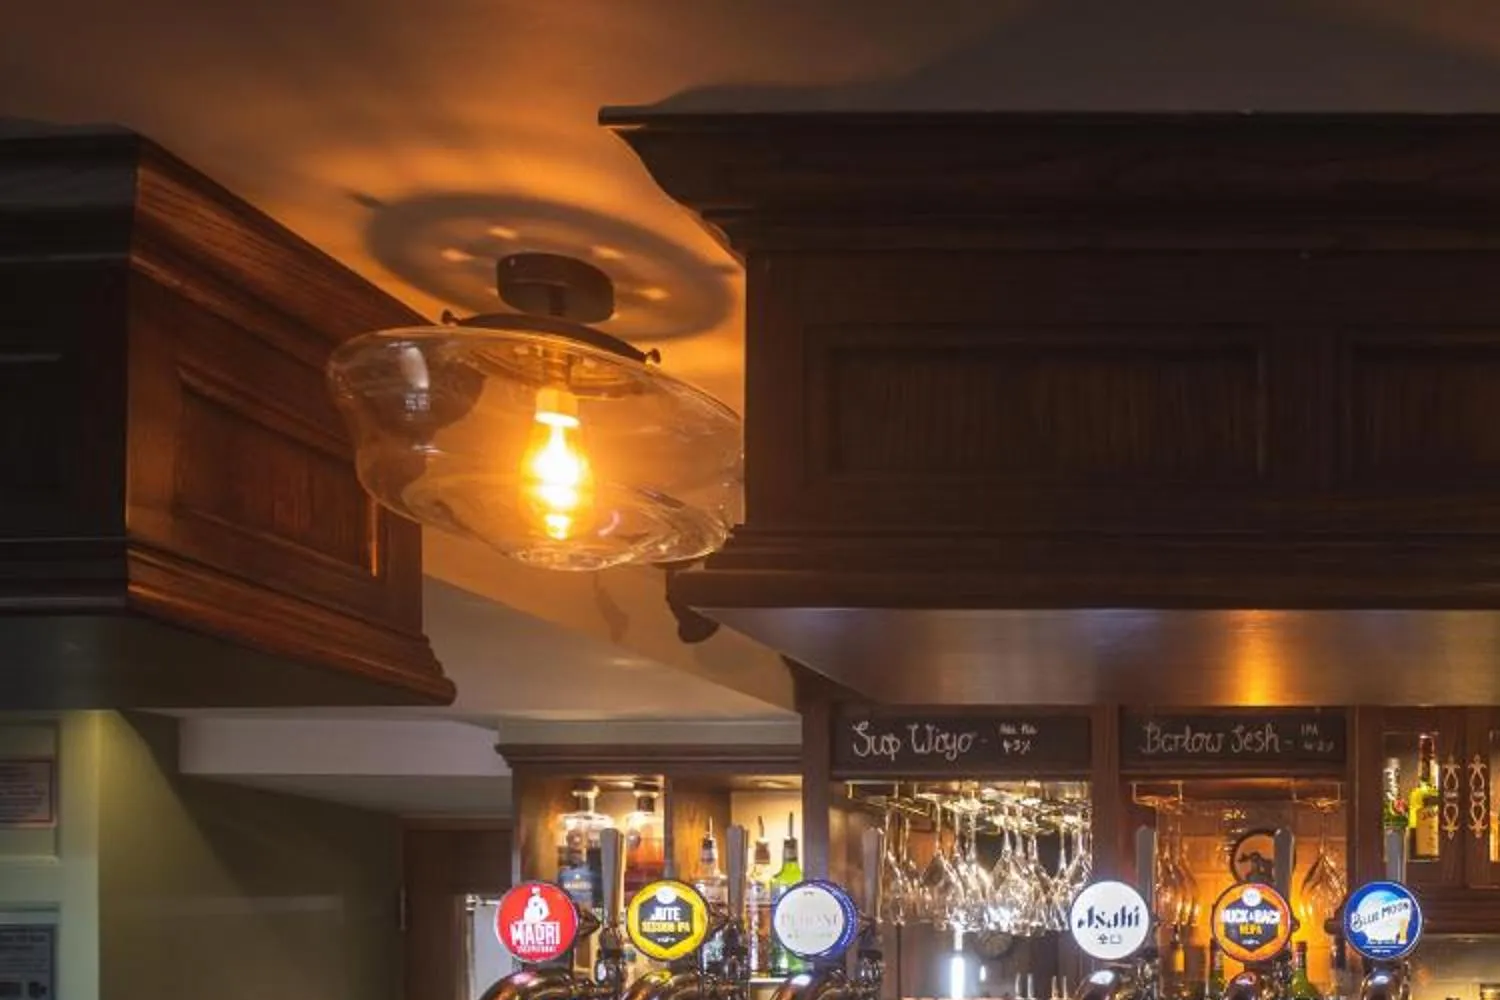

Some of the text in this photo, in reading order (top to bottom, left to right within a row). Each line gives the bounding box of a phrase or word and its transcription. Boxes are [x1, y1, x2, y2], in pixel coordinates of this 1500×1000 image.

[1142, 722, 1225, 754] Barlow
[648, 906, 682, 921] JUTE
[1077, 905, 1141, 929] Asahi
